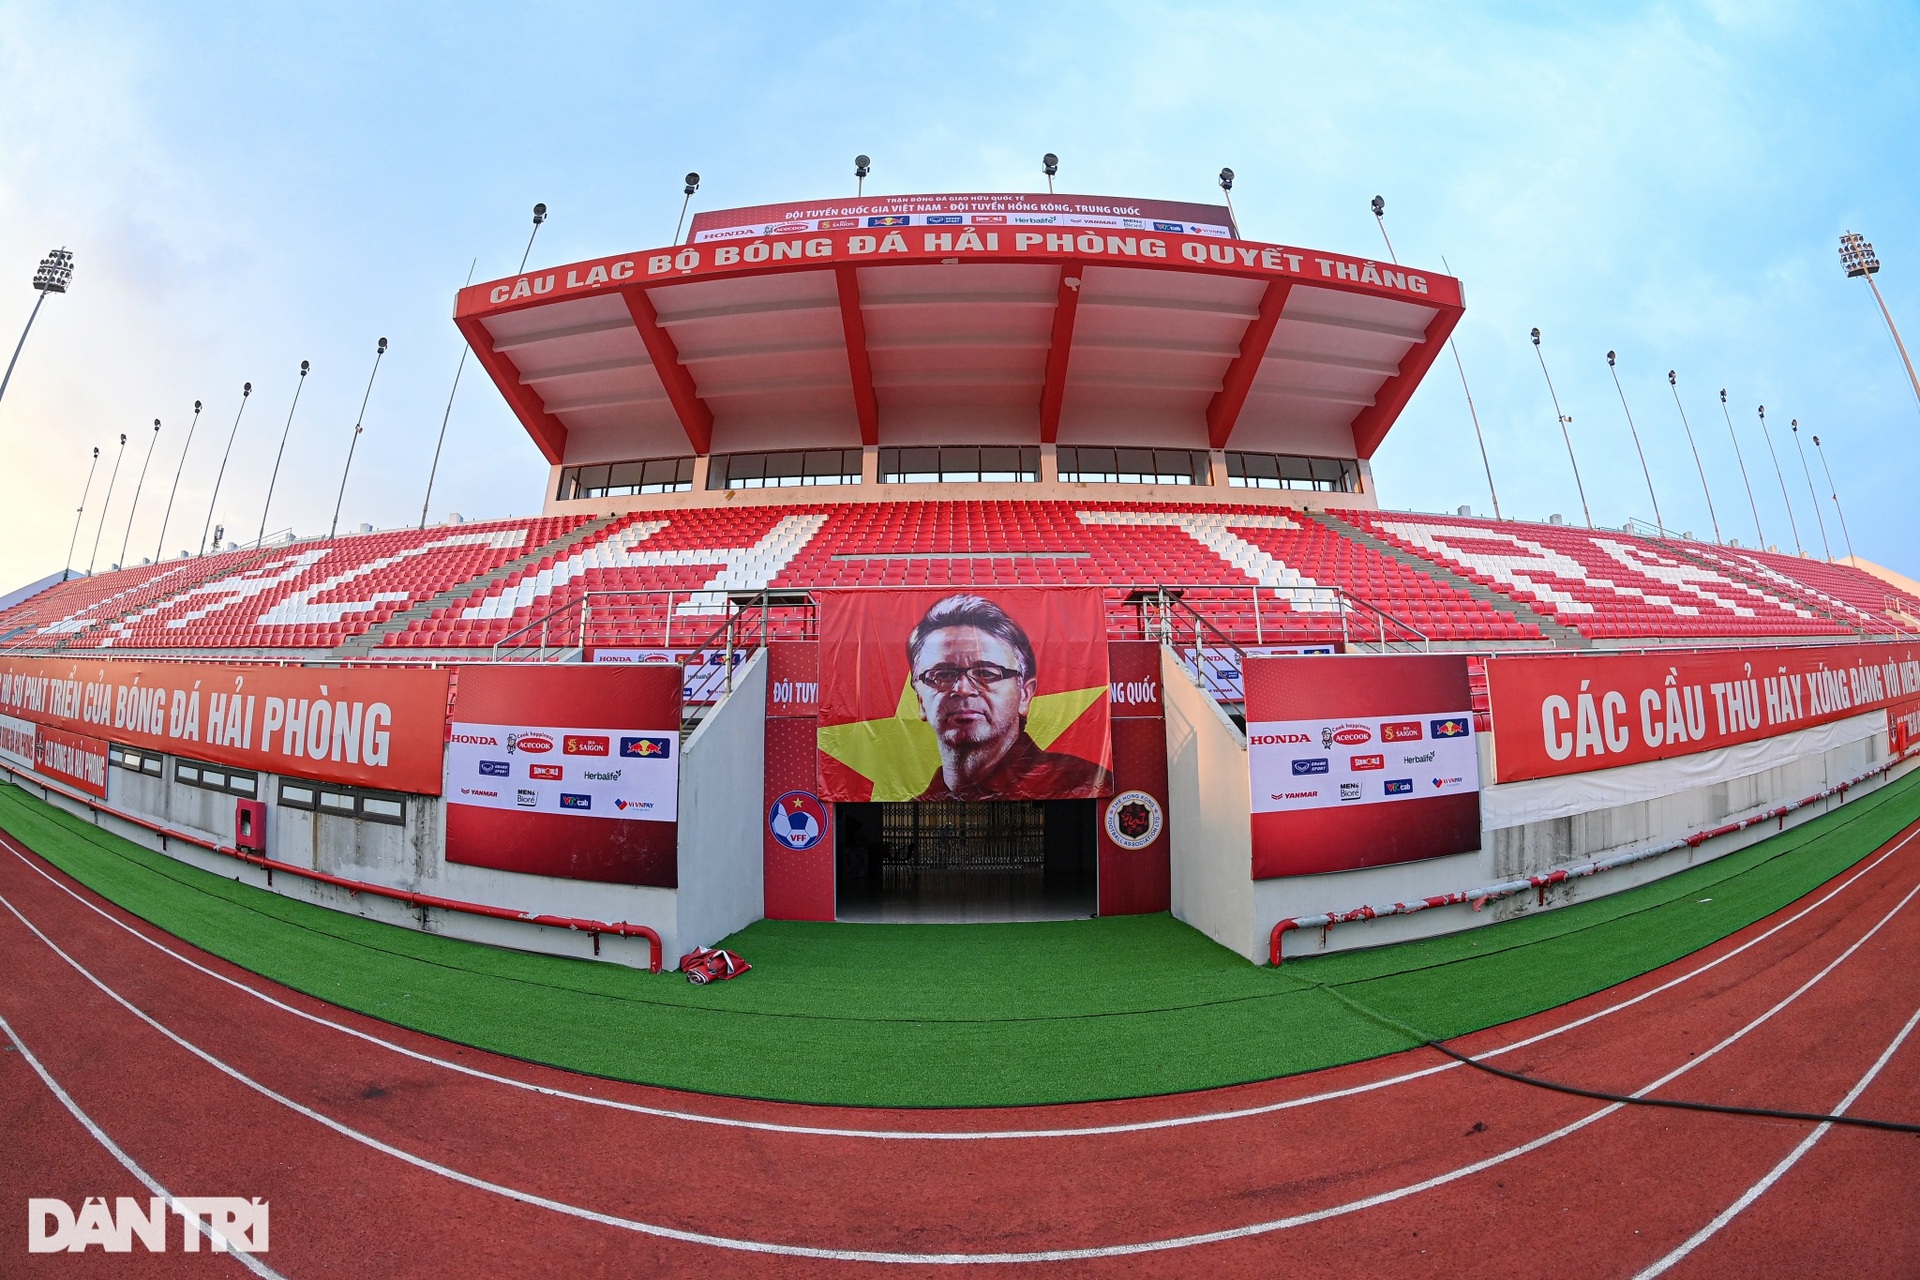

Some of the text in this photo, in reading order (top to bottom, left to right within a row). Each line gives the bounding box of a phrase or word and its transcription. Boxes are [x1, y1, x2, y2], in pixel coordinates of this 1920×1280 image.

[785, 211, 804, 220] ĐỘI
[841, 205, 869, 216] QUỐC
[871, 206, 889, 214] GIA
[891, 203, 915, 214] VIỆT
[917, 203, 942, 212] NAM
[950, 202, 969, 213] ĐỘI
[1075, 204, 1111, 214] TRUNG
[1112, 205, 1141, 216] QUỐC
[703, 229, 755, 240] HONDA
[489, 226, 1428, 304] CÂU LẠC BỘ BÓNG ĐÁ HẢI PHÒNG QUYẾT THẮNG
[773, 677, 819, 709] ĐỘI TUY
[1127, 675, 1157, 706] QUỐC
[1541, 679, 1630, 761] CÁC
[1639, 666, 1707, 748] CẦU
[1710, 661, 1761, 736] THỦ
[1763, 666, 1804, 726] HÃY
[1806, 662, 1851, 717] XỨNG
[1849, 658, 1884, 706] ĐÁNG
[1882, 656, 1901, 699] VỚI
[11, 672, 26, 715] SỰ
[23, 669, 49, 713] PHÁT
[49, 664, 83, 720] TRIỂN
[83, 669, 112, 726] CỦA
[114, 676, 166, 736] BÓNG
[169, 680, 201, 741] ĐÁ
[206, 675, 255, 750] HẢI
[261, 684, 392, 768] PHÒNG
[1250, 733, 1312, 746] HONDA
[1396, 729, 1418, 737] SAIGON
[451, 734, 498, 746] HONDA
[579, 743, 604, 752] SAIGON
[1404, 752, 1434, 764] Herbalife
[584, 770, 619, 781] Herbalife
[471, 789, 498, 798] YANMAR
[1285, 791, 1318, 799] YANMAR
[1112, 798, 1122, 809] THE
[1140, 795, 1155, 808] KONG
[1124, 828, 1158, 847] ASSOCIATION
